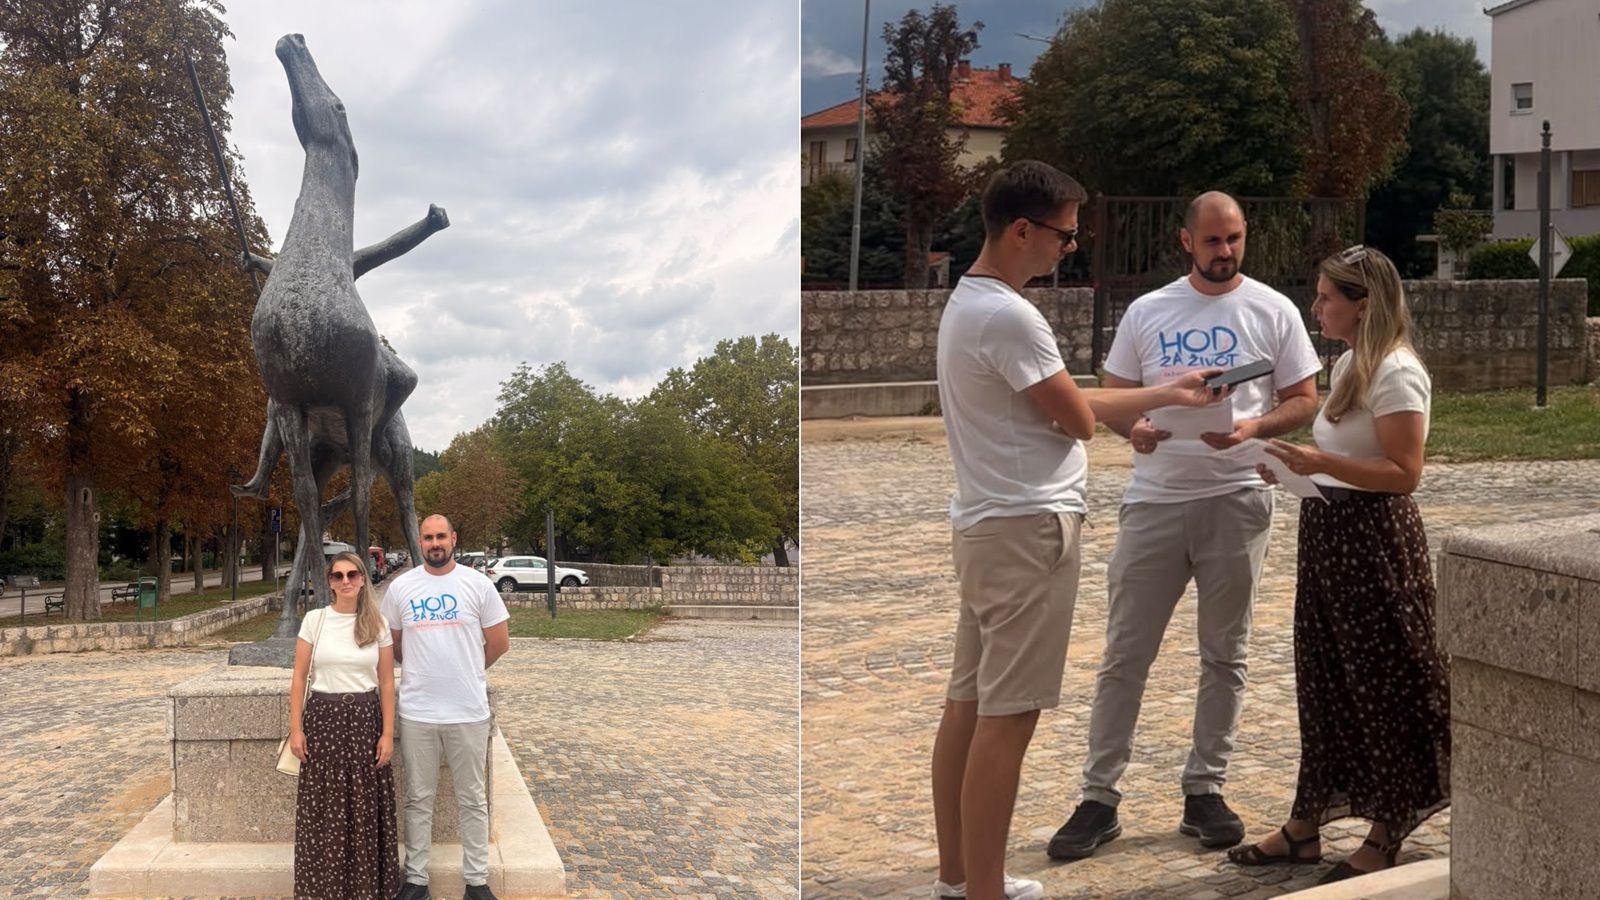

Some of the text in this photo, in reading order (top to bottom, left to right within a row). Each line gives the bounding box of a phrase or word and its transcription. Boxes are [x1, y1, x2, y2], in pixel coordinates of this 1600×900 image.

[1159, 326, 1237, 356] HOD
[1160, 352, 1183, 367] ZA
[410, 594, 457, 613] HOD
[413, 612, 426, 621] ZA
